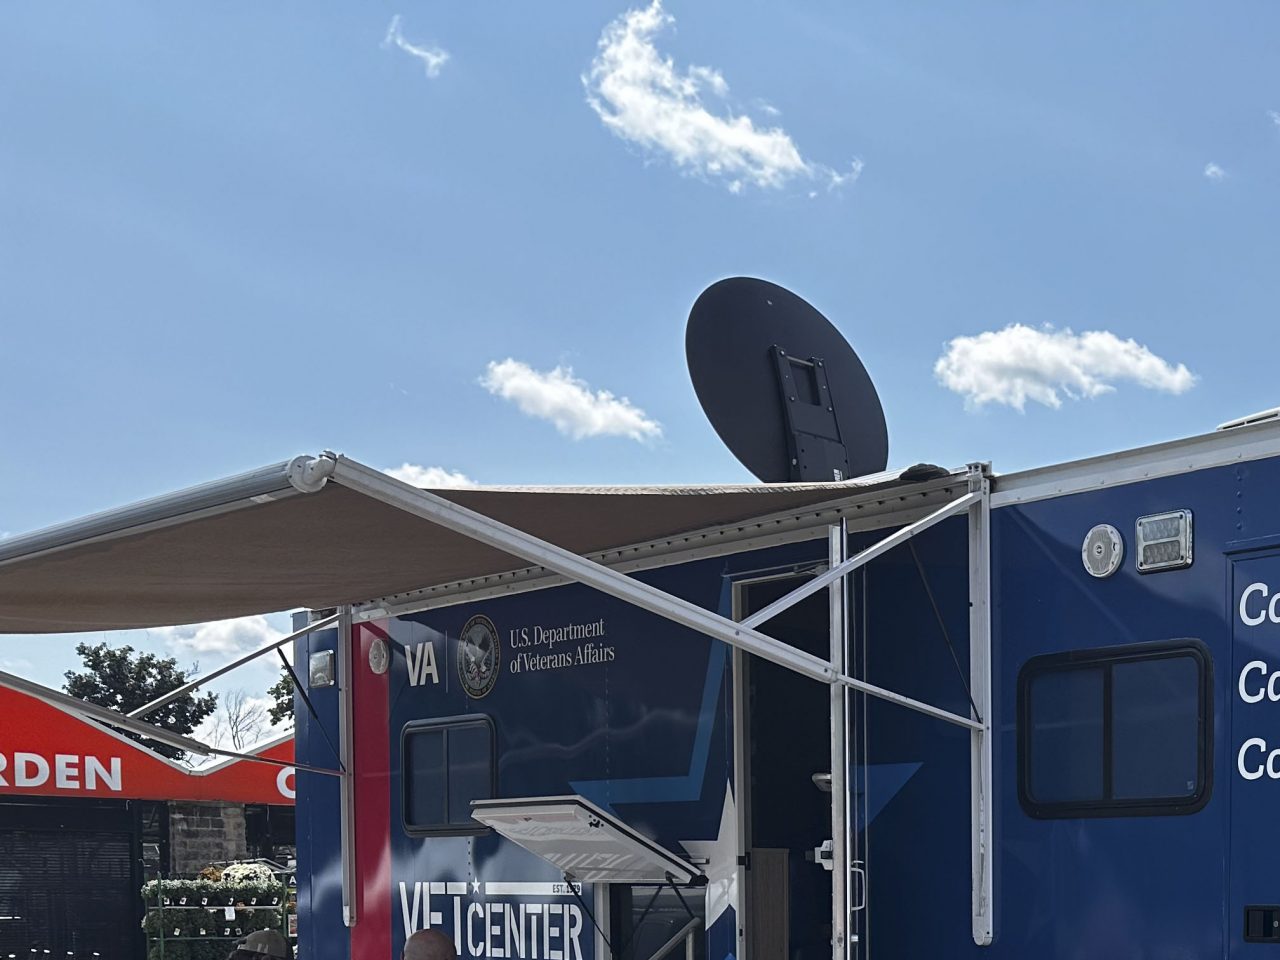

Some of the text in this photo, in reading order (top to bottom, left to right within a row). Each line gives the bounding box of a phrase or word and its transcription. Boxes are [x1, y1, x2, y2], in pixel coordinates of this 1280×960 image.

[509, 618, 605, 648] U.S. Department
[405, 641, 440, 686] VA
[510, 643, 615, 674] of Veterans Affairs
[0, 751, 122, 791] DEN
[552, 884, 566, 894] EST.
[467, 902, 583, 960] CENTER
